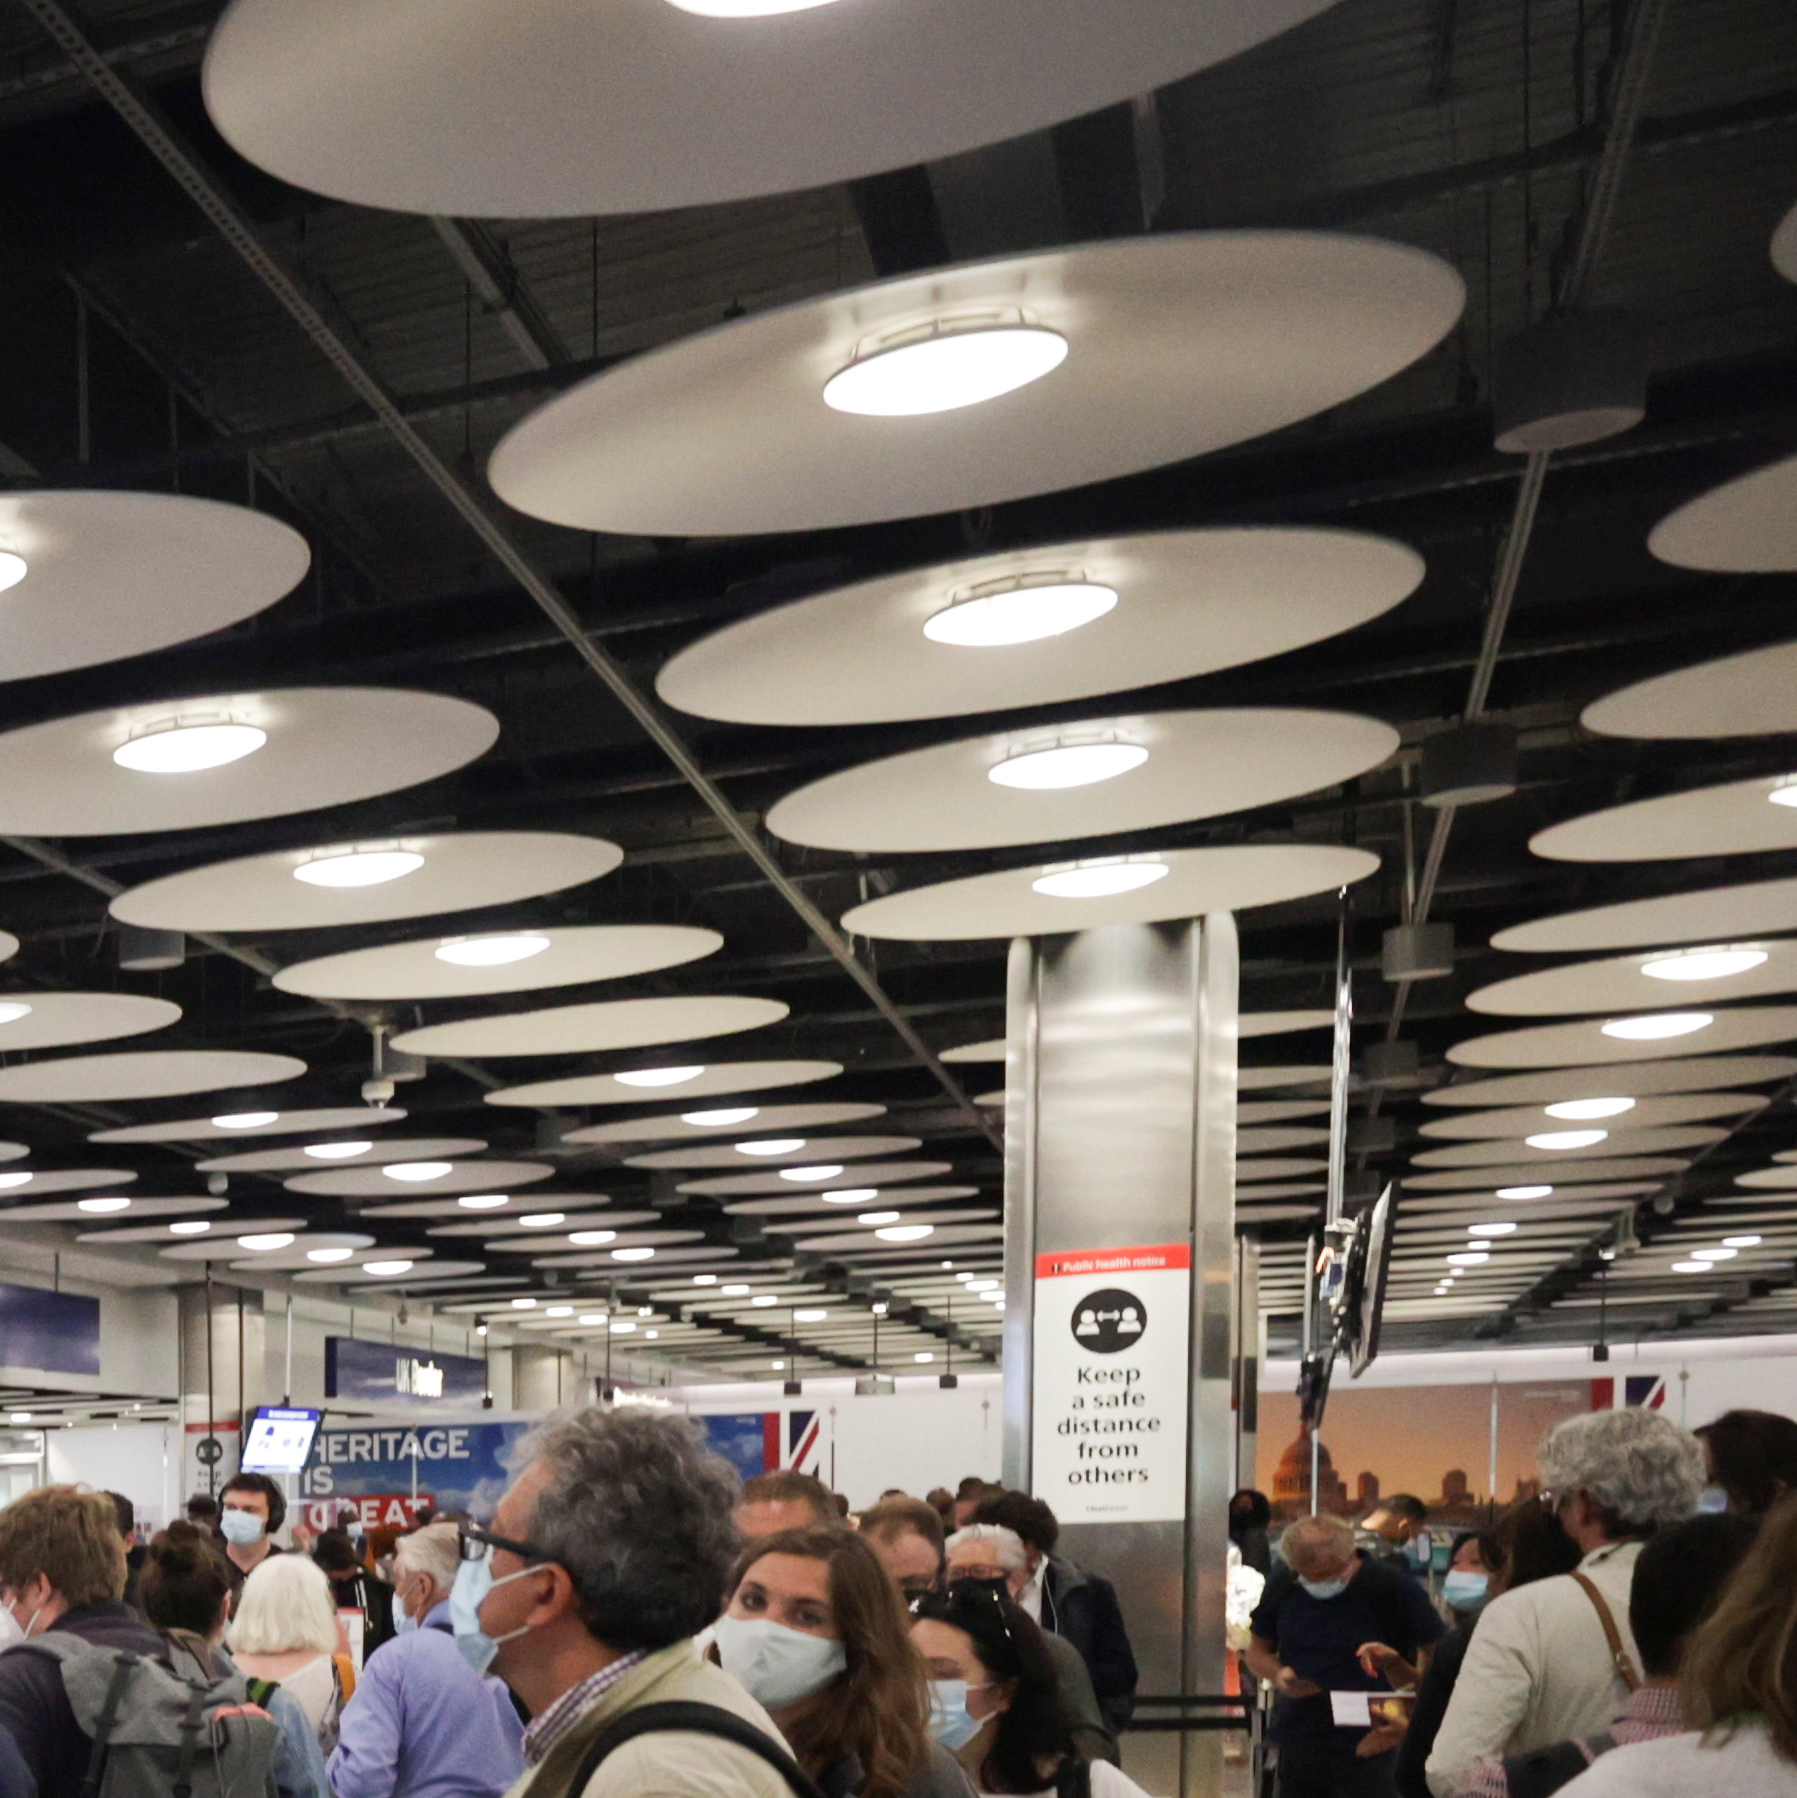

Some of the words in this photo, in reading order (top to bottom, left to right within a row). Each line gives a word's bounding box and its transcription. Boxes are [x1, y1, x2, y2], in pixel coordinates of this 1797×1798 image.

[1063, 1261, 1093, 1273] Public
[1095, 1258, 1131, 1270] health
[1133, 1256, 1166, 1267] notice
[1077, 1366, 1141, 1387] Keep
[1072, 1396, 1085, 1410] a
[1093, 1388, 1145, 1410] safe
[1057, 1416, 1161, 1436] distance
[314, 1430, 471, 1464] HERITAGE
[1078, 1441, 1138, 1460] from
[304, 1466, 334, 1494] IS
[1068, 1466, 1149, 1485] others
[309, 1499, 430, 1532] GEAT
